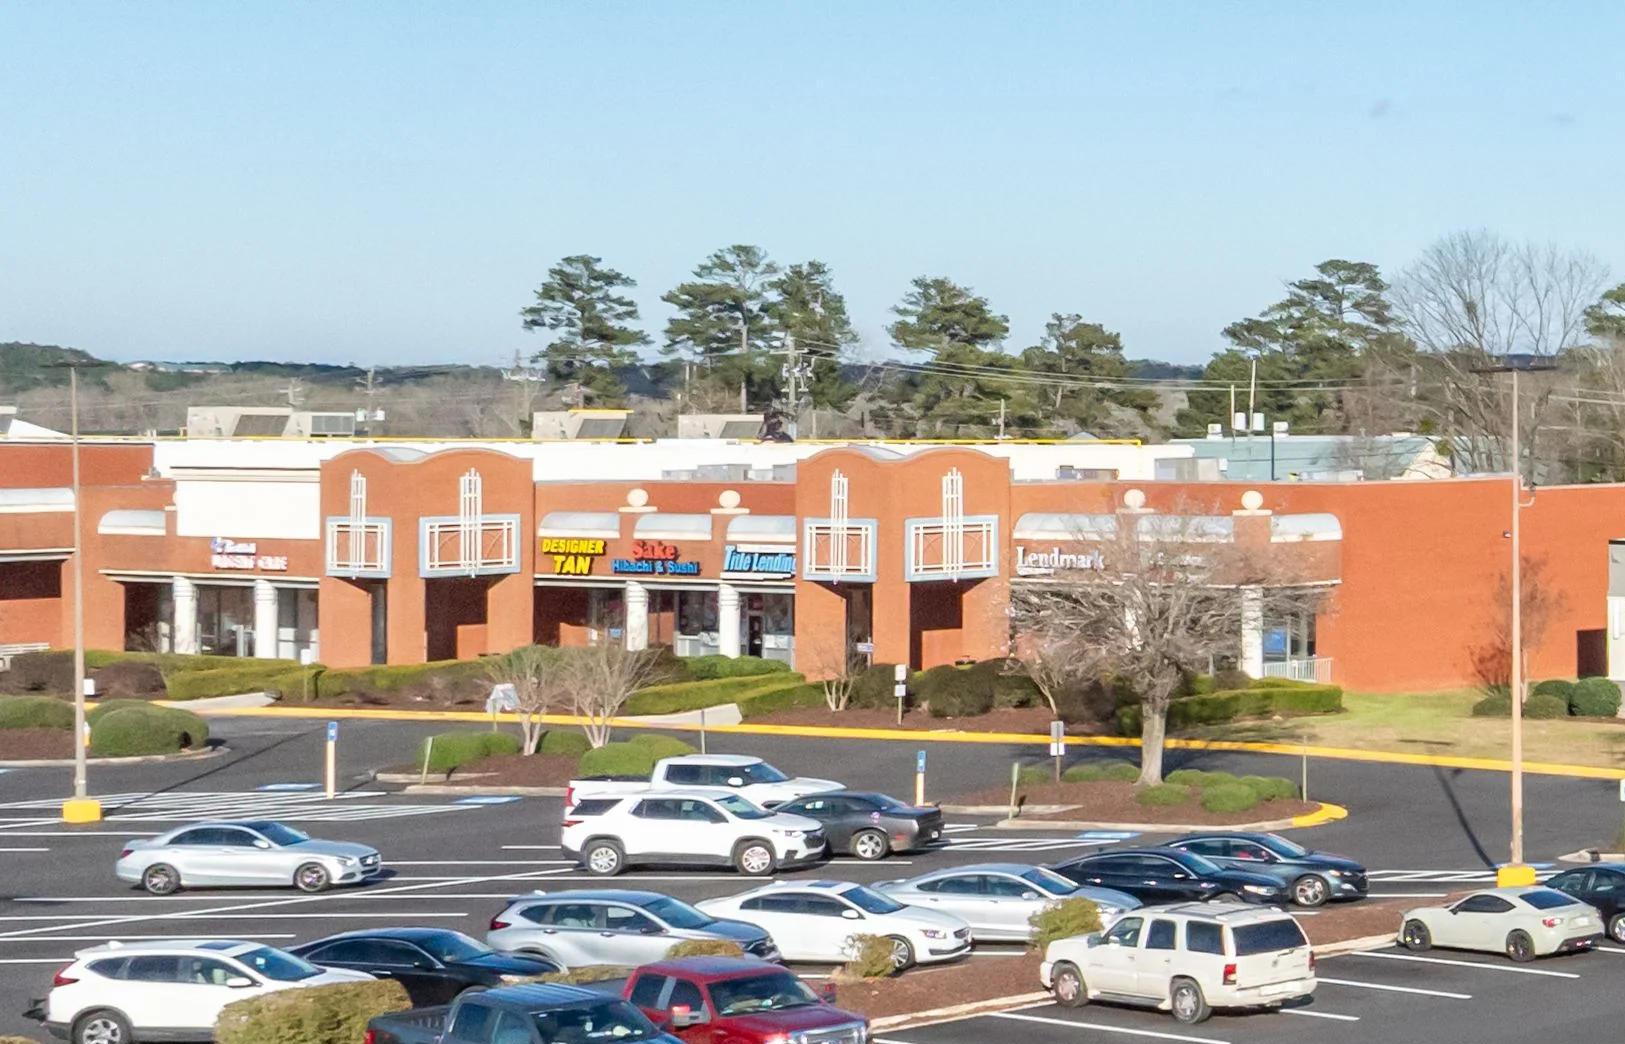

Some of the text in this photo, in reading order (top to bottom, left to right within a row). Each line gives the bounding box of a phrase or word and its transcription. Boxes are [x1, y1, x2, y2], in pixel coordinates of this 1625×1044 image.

[542, 539, 605, 553] DESIGNER
[632, 540, 676, 560] Sake
[553, 556, 591, 574] TAN
[611, 560, 652, 573] Hibachi
[668, 561, 698, 573] Sushi
[1016, 546, 1105, 569] Lendmark
